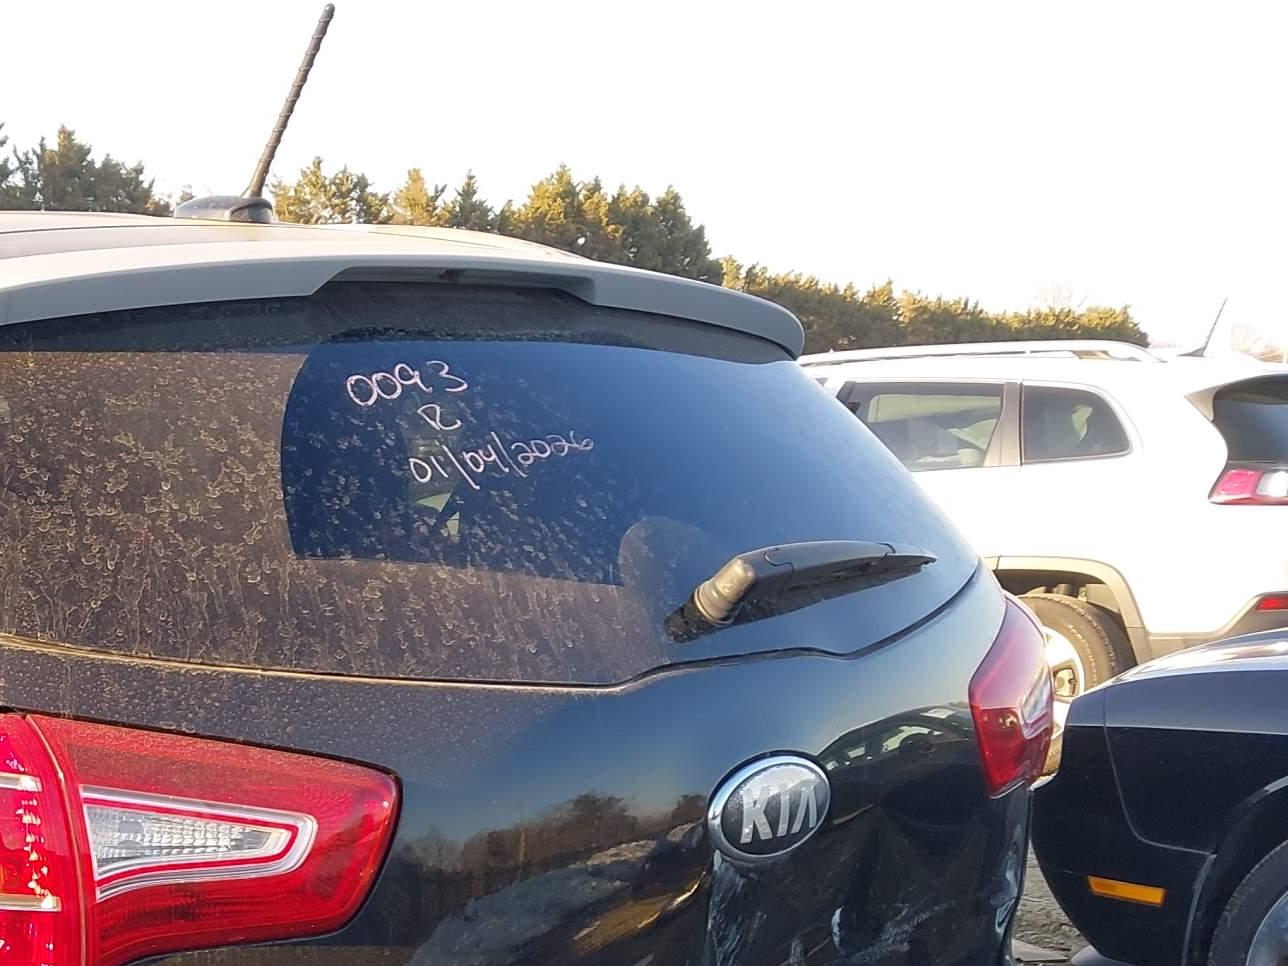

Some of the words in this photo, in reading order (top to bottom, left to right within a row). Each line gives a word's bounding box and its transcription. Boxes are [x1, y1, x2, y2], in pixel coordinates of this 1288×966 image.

[346, 360, 468, 406] 0093
[408, 430, 594, 490] 01/04/2026
[739, 784, 818, 844] KIA
